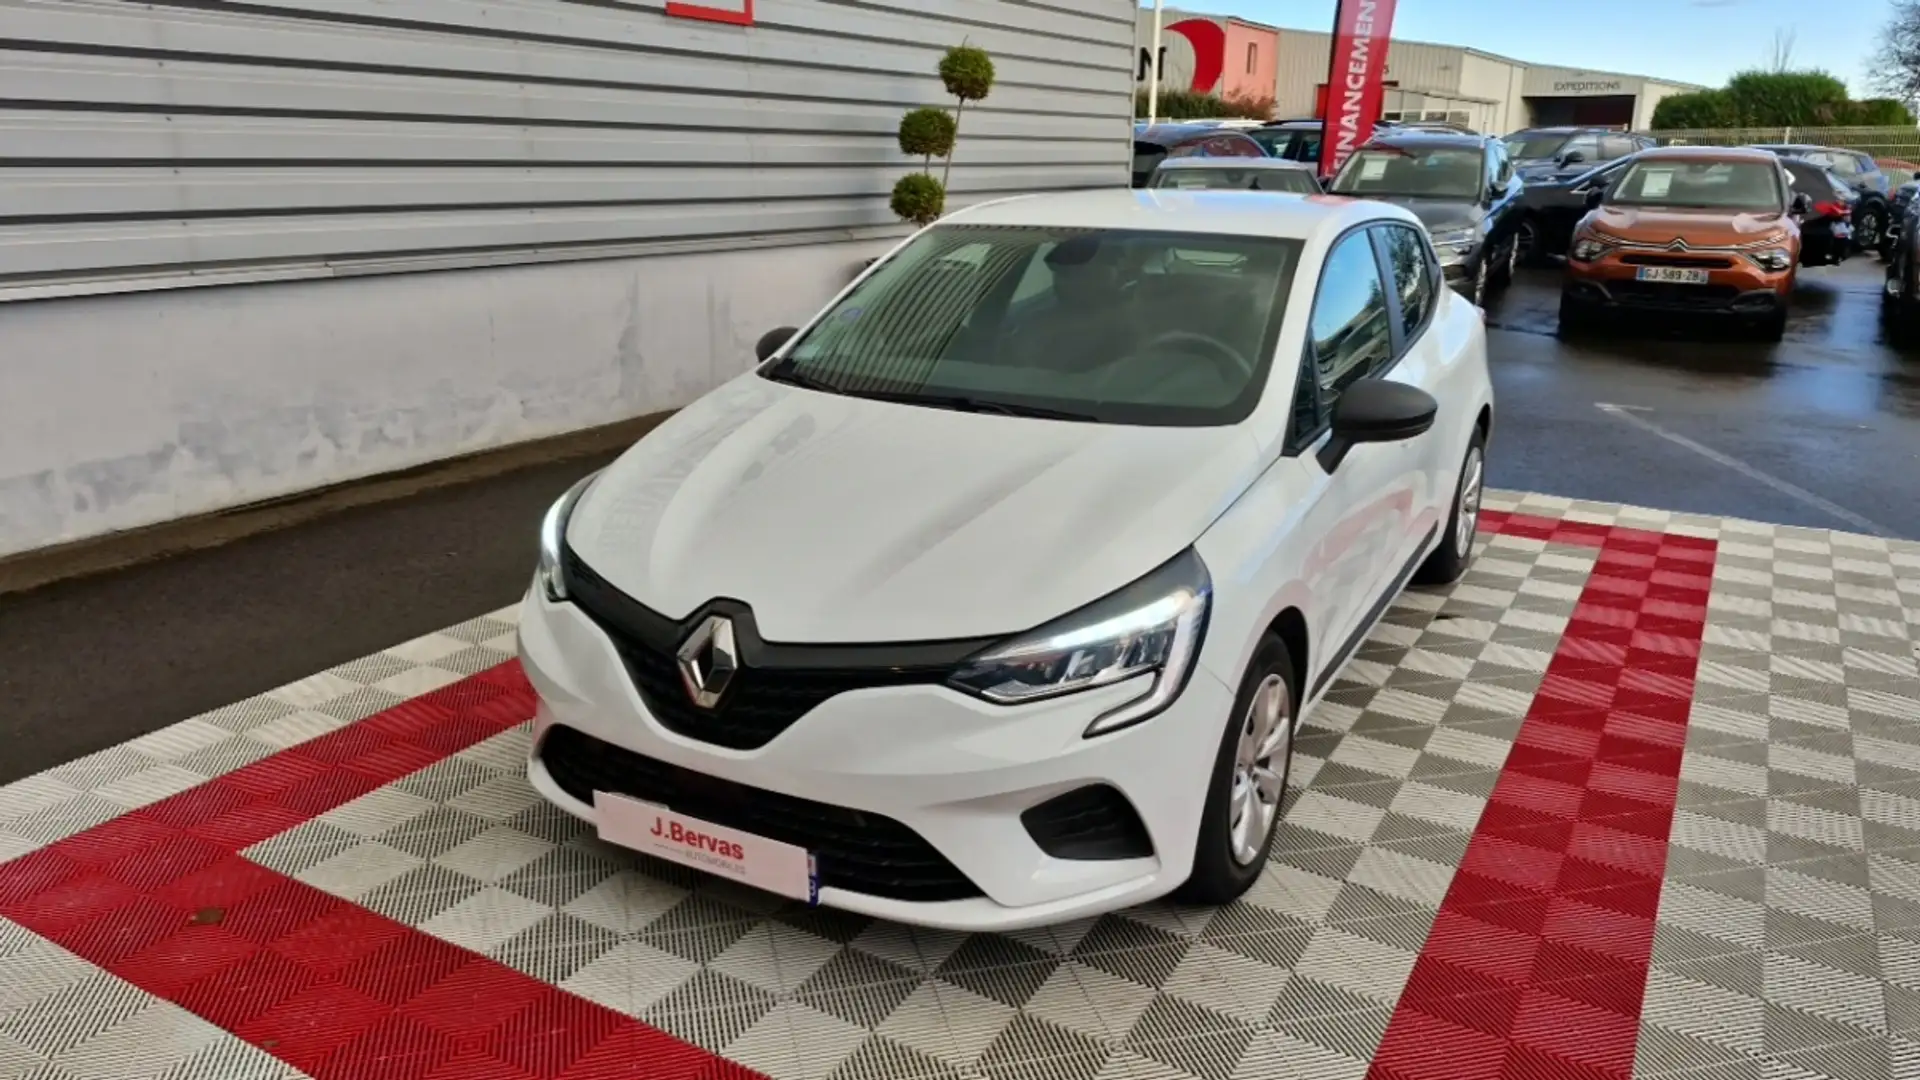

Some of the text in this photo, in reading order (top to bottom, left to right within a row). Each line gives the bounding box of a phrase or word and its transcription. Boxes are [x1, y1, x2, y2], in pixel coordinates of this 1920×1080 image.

[1334, 0, 1377, 169] FINANCEMEN
[1553, 80, 1621, 92] EXPEDITIONS
[650, 816, 745, 860] J.Bervas
